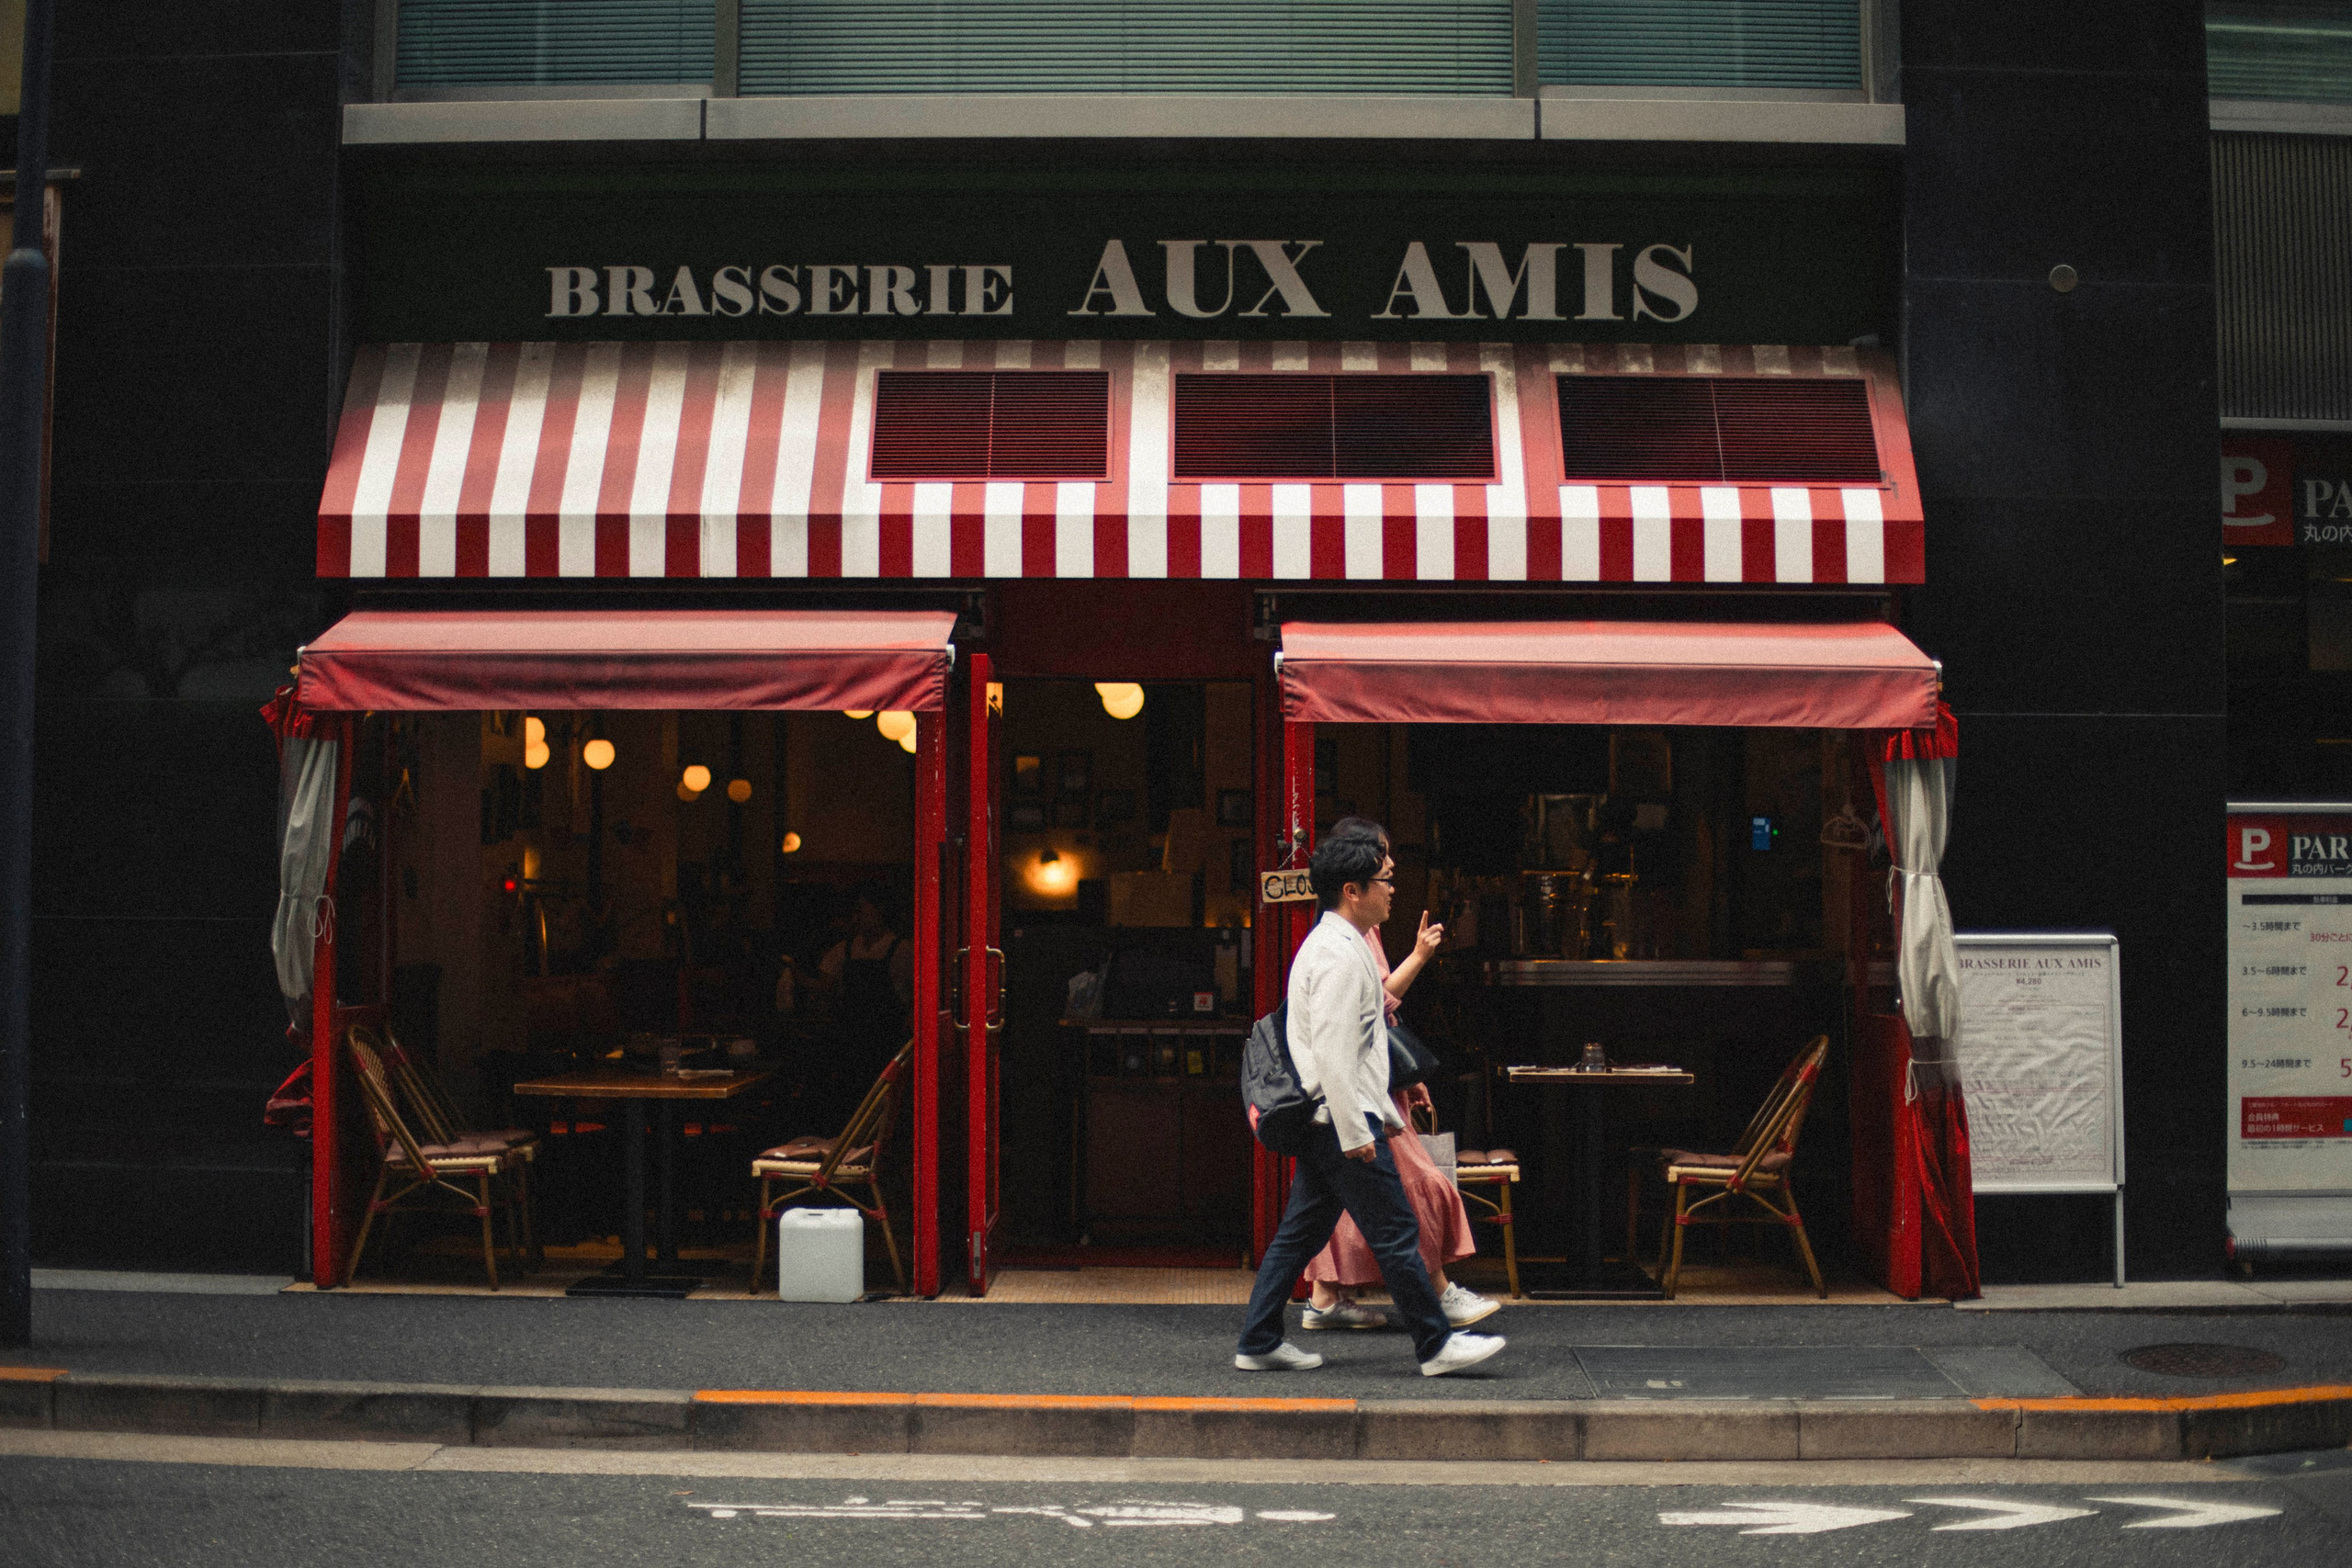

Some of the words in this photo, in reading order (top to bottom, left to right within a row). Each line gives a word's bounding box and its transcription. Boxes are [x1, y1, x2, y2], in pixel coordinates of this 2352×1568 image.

[544, 264, 1014, 319] BRASSERIE
[1067, 238, 1332, 319] AUX
[1370, 240, 1700, 324] AMIS
[2303, 479, 2352, 518] PA
[2242, 828, 2271, 863] P
[2292, 836, 2352, 860] PAR
[2035, 958, 2063, 969] AUX
[2067, 958, 2102, 969] AMIS
